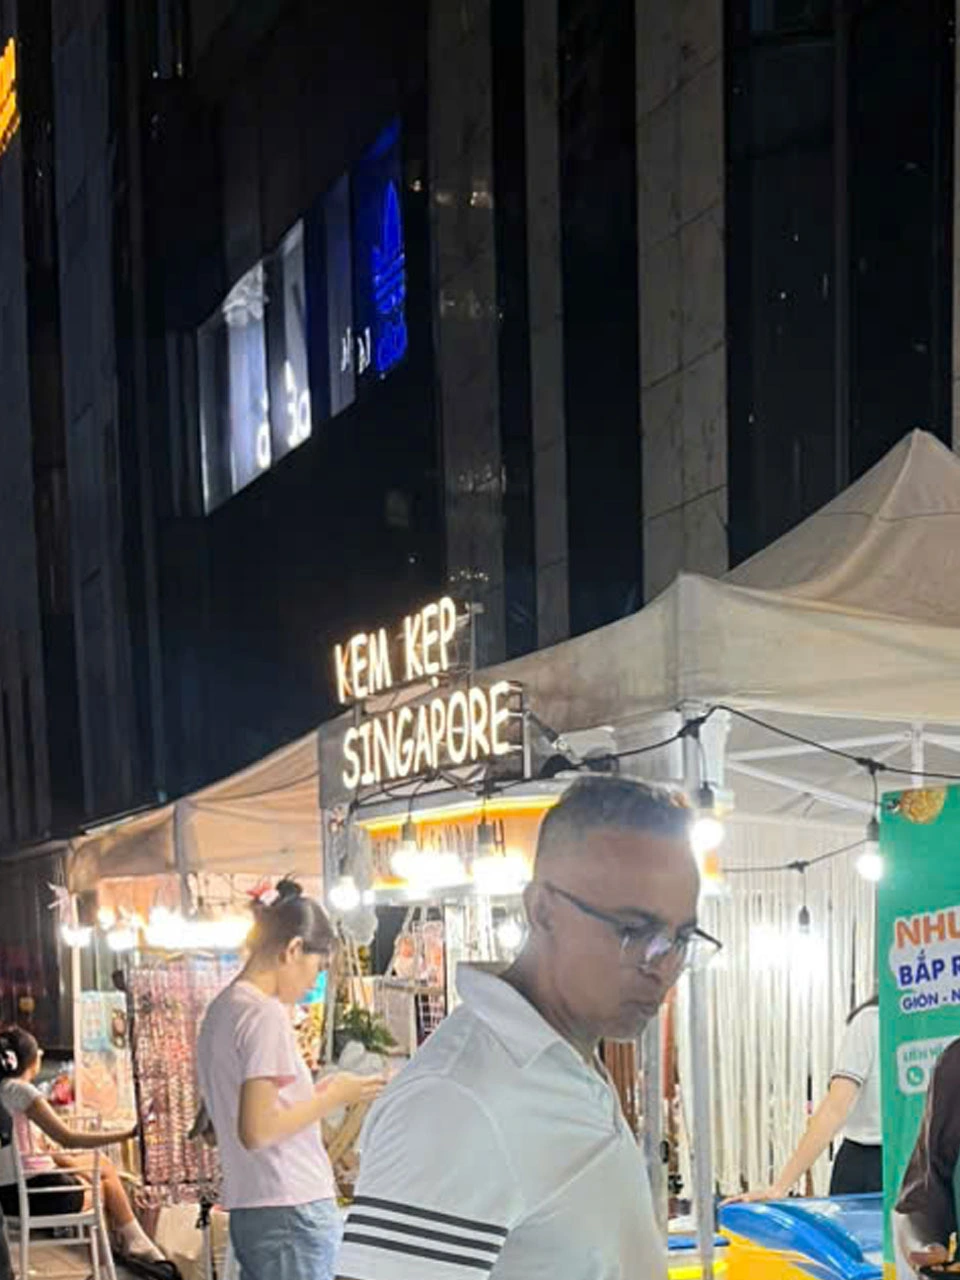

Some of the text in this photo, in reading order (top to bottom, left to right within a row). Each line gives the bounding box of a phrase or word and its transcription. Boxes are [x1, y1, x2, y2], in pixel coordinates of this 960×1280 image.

[335, 596, 457, 703] KEM KẸP
[343, 680, 511, 788] SINGAPORE
[899, 949, 945, 986] BẮP
